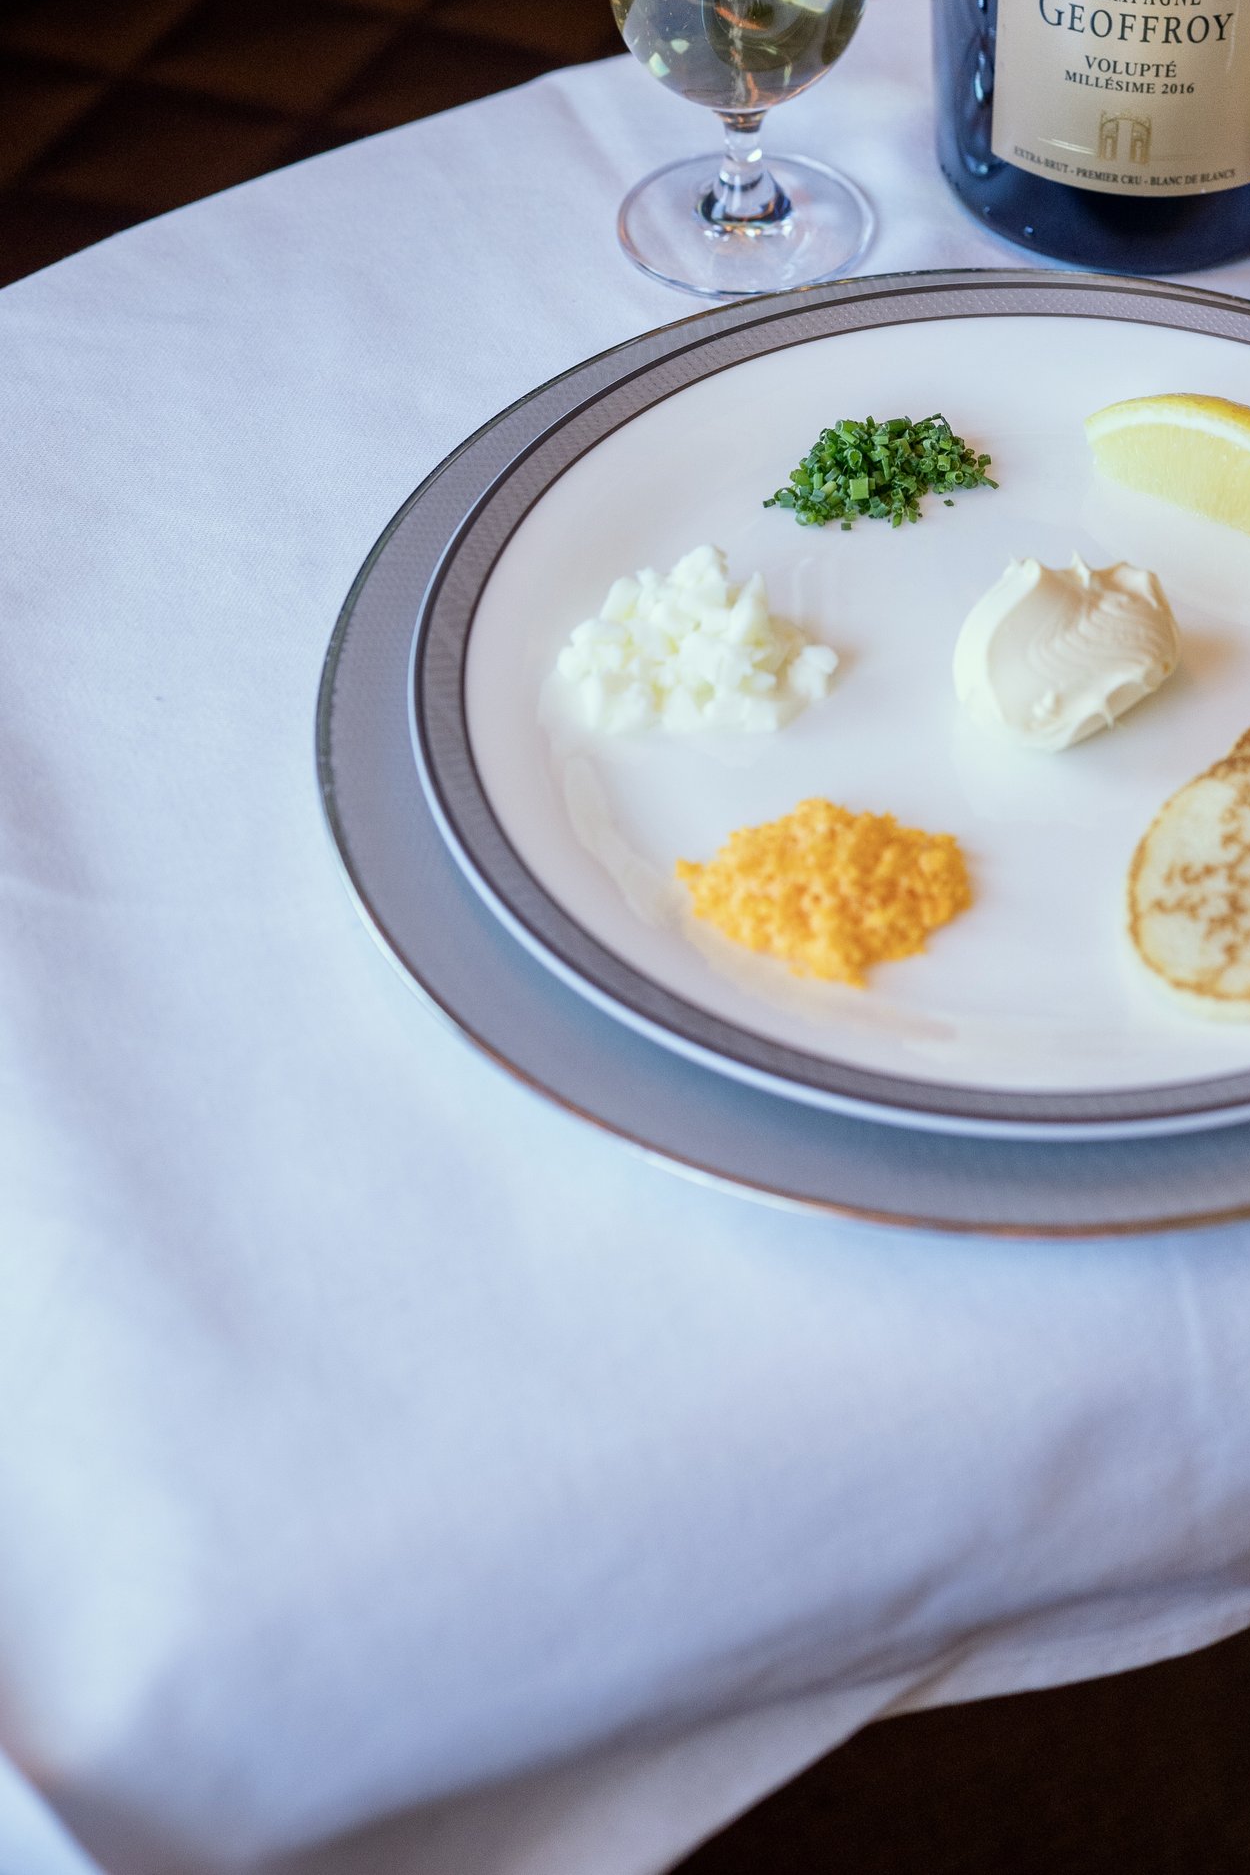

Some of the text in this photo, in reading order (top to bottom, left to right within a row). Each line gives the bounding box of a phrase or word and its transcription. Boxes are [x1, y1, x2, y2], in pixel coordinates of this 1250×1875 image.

[1084, 55, 1177, 78] VOLUPTÉ
[1064, 69, 1195, 94] MILLÉSIME 2016
[1076, 167, 1119, 184] PREMIER
[1121, 174, 1142, 185] CRU
